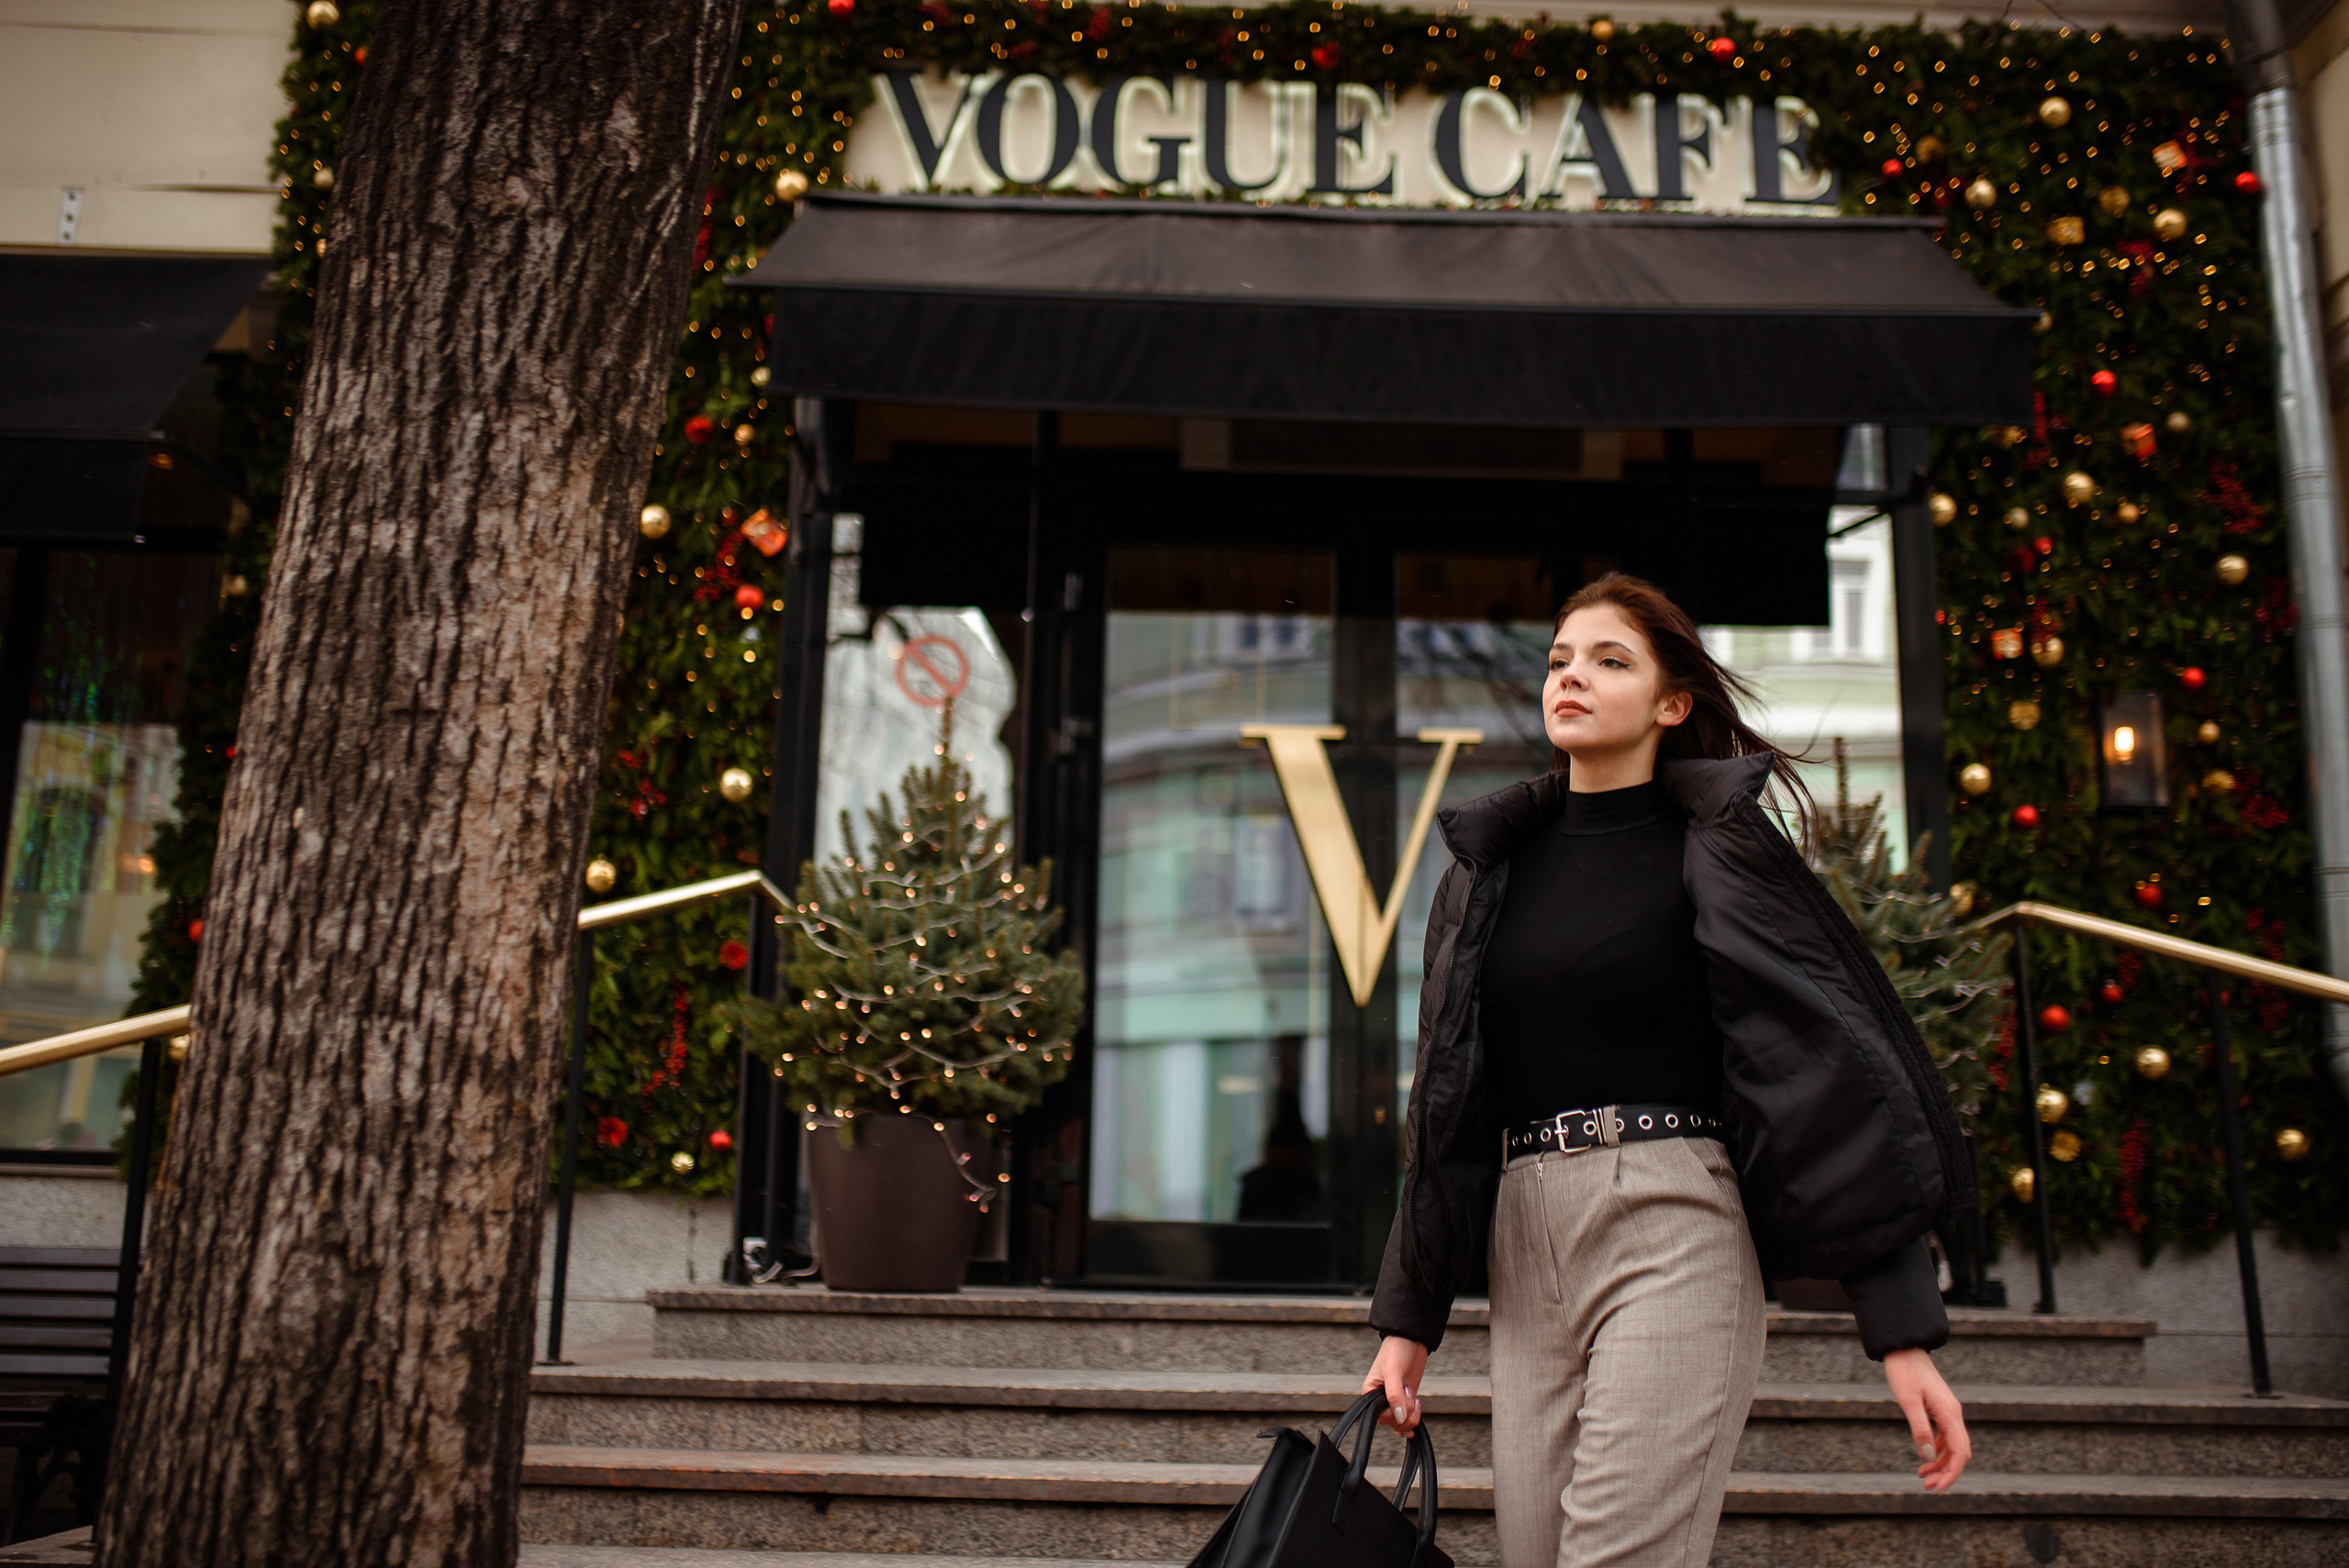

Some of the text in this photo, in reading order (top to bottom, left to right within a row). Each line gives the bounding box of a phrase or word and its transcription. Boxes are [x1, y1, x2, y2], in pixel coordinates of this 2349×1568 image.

[874, 70, 1841, 206] VOGUE CAFE
[1241, 724, 1484, 1006] V
